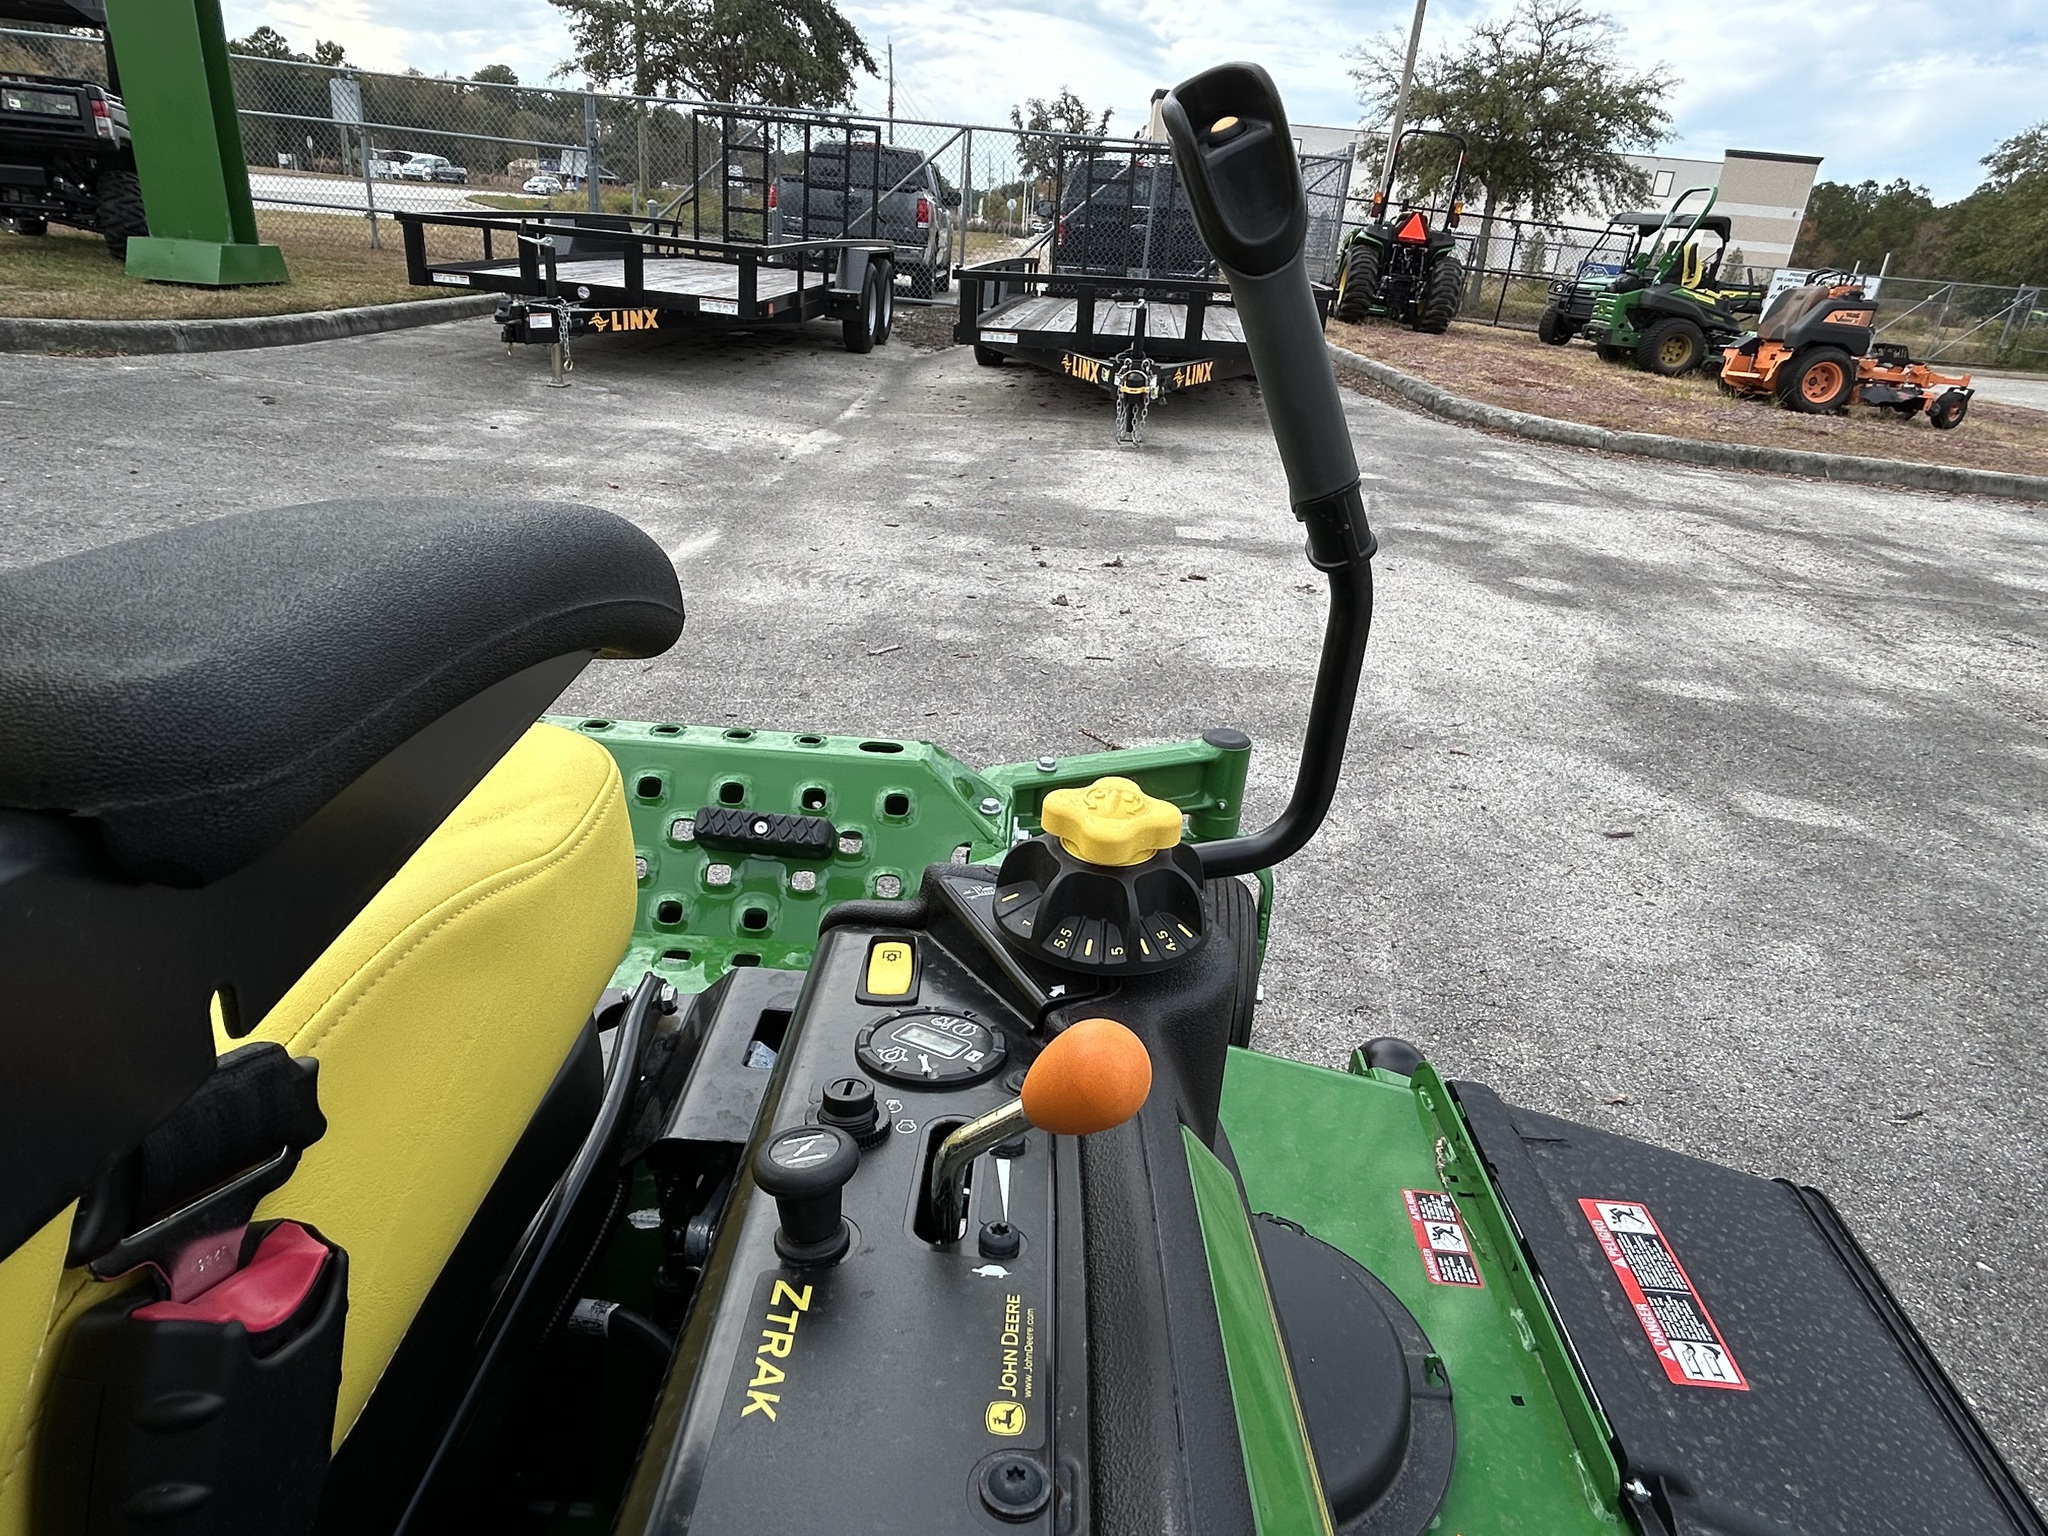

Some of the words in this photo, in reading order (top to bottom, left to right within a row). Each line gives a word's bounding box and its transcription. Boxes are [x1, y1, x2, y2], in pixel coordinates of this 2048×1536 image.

[611, 308, 660, 332] LINX
[1071, 355, 1101, 384] LINX
[1184, 360, 1215, 387] LINX
[1053, 927, 1073, 949] 5.5
[1110, 946, 1124, 957] 5
[1591, 1219, 1622, 1258] PELIGRO
[1422, 1248, 1439, 1278] DANGER
[1000, 1294, 1020, 1346] DEERE
[1635, 1303, 1668, 1347] DANGER
[741, 1279, 813, 1422] ZTRAK
[1023, 1308, 1034, 1398] www.JohnDeere.com
[998, 1349, 1018, 1397] JOHN
